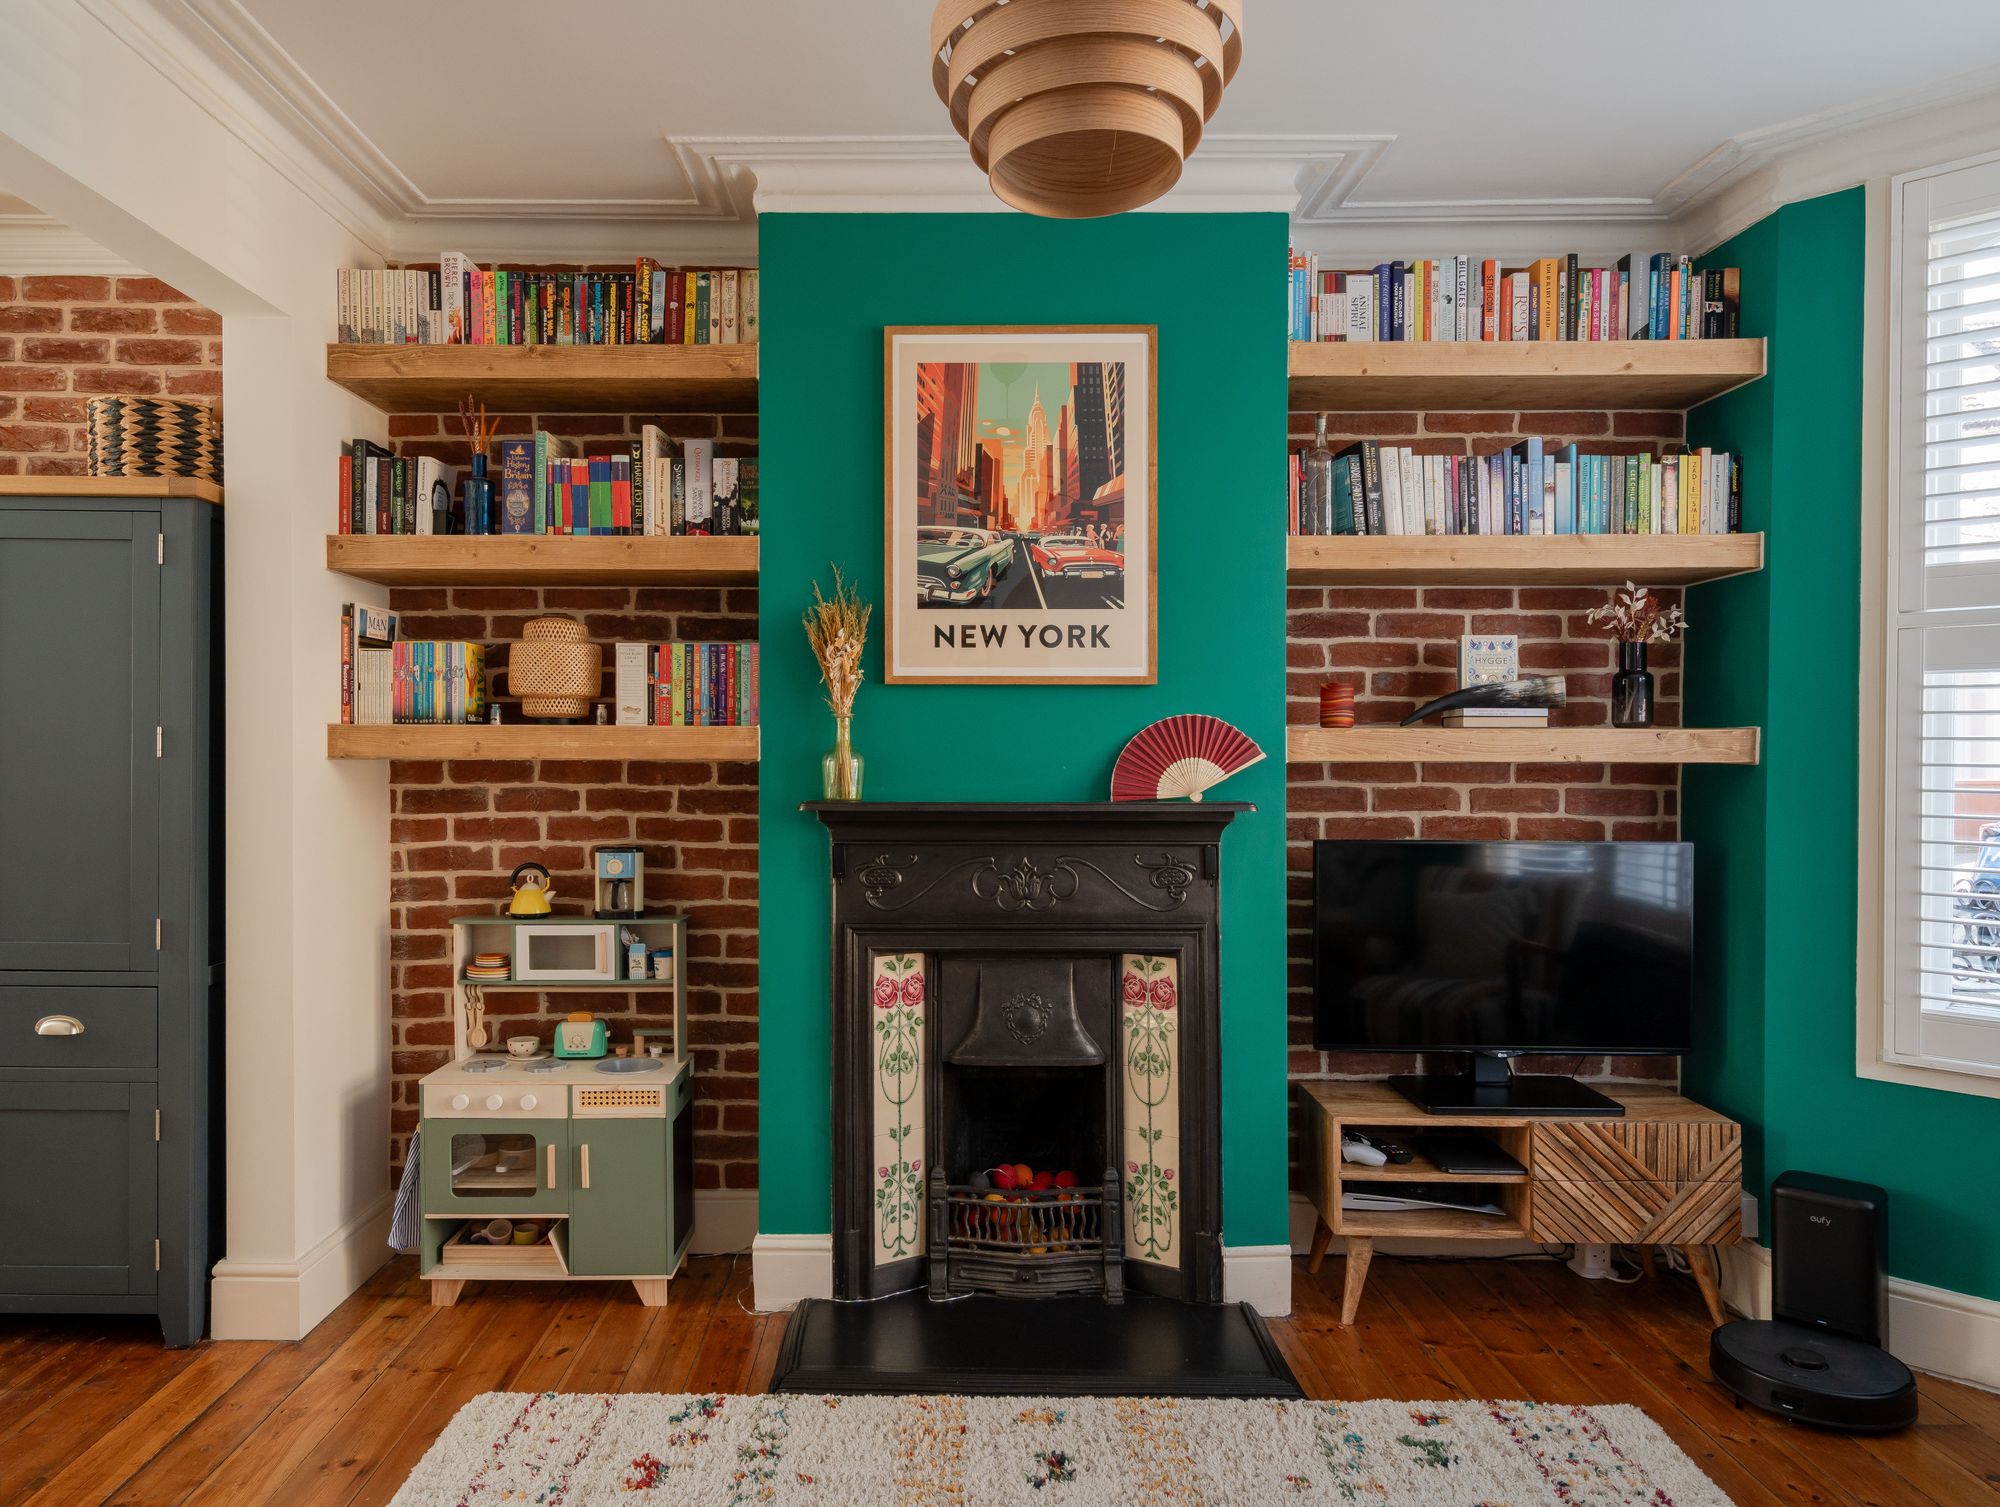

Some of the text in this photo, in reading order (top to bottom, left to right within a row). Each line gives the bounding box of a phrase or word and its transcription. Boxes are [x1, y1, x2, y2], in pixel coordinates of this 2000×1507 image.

[1514, 296, 1527, 332] ROOTS
[1561, 316, 1564, 324] TO
[507, 460, 529, 471] History
[505, 469, 532, 480] Britain
[368, 617, 387, 631] MAN
[934, 624, 1111, 648] NEW YORK
[1810, 1216, 1831, 1226] eufy
